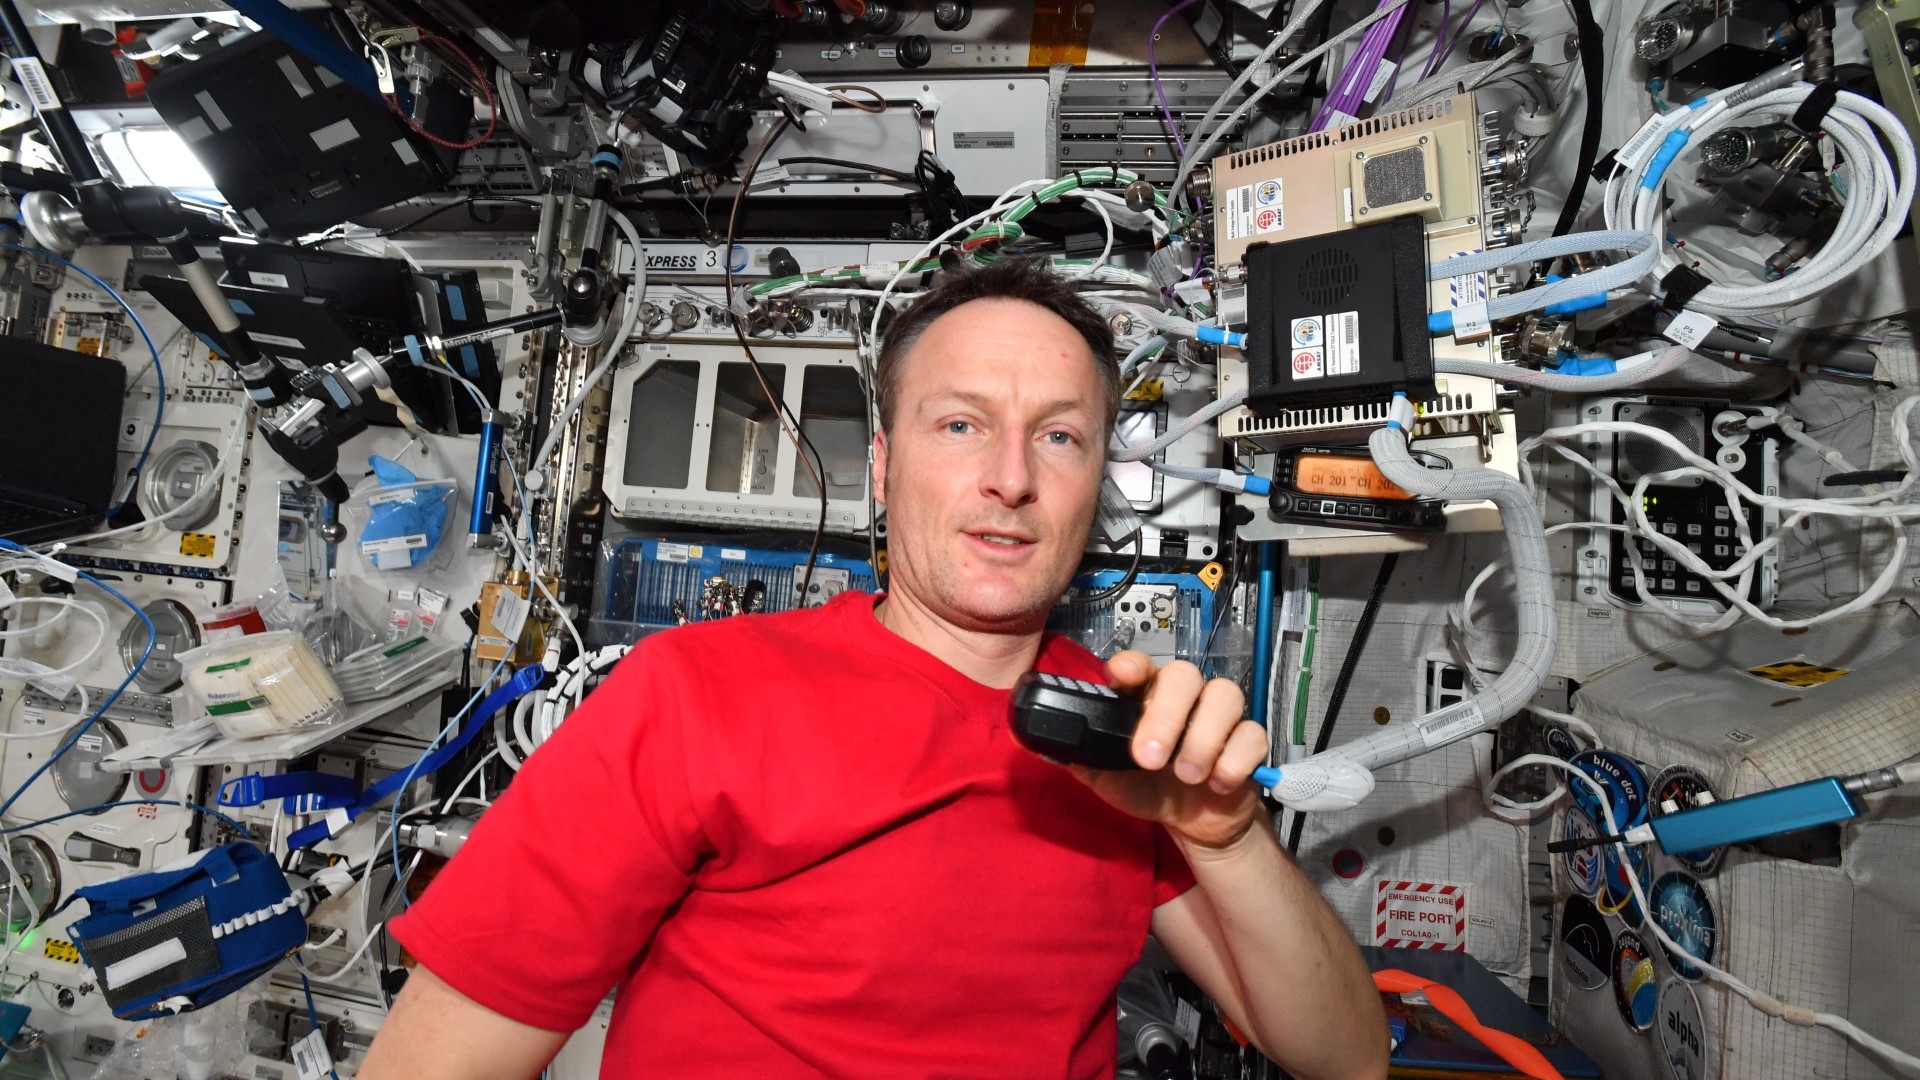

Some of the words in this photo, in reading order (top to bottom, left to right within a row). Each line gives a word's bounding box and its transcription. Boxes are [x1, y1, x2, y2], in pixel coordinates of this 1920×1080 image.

[705, 250, 717, 268] 3
[1683, 325, 1694, 334] P5
[1311, 475, 1324, 485] CH
[1329, 475, 1347, 486] 201
[1358, 477, 1371, 489] CH
[1593, 754, 1620, 778] blue
[1620, 779, 1638, 801] dot
[1388, 893, 1436, 904] EMERGENCY
[1438, 897, 1455, 906] USE
[1389, 909, 1416, 922] FIRE
[1419, 911, 1454, 925] PORT
[1660, 904, 1711, 949] proxima
[1618, 937, 1641, 951] beyond
[1668, 1010, 1700, 1058] alpha
